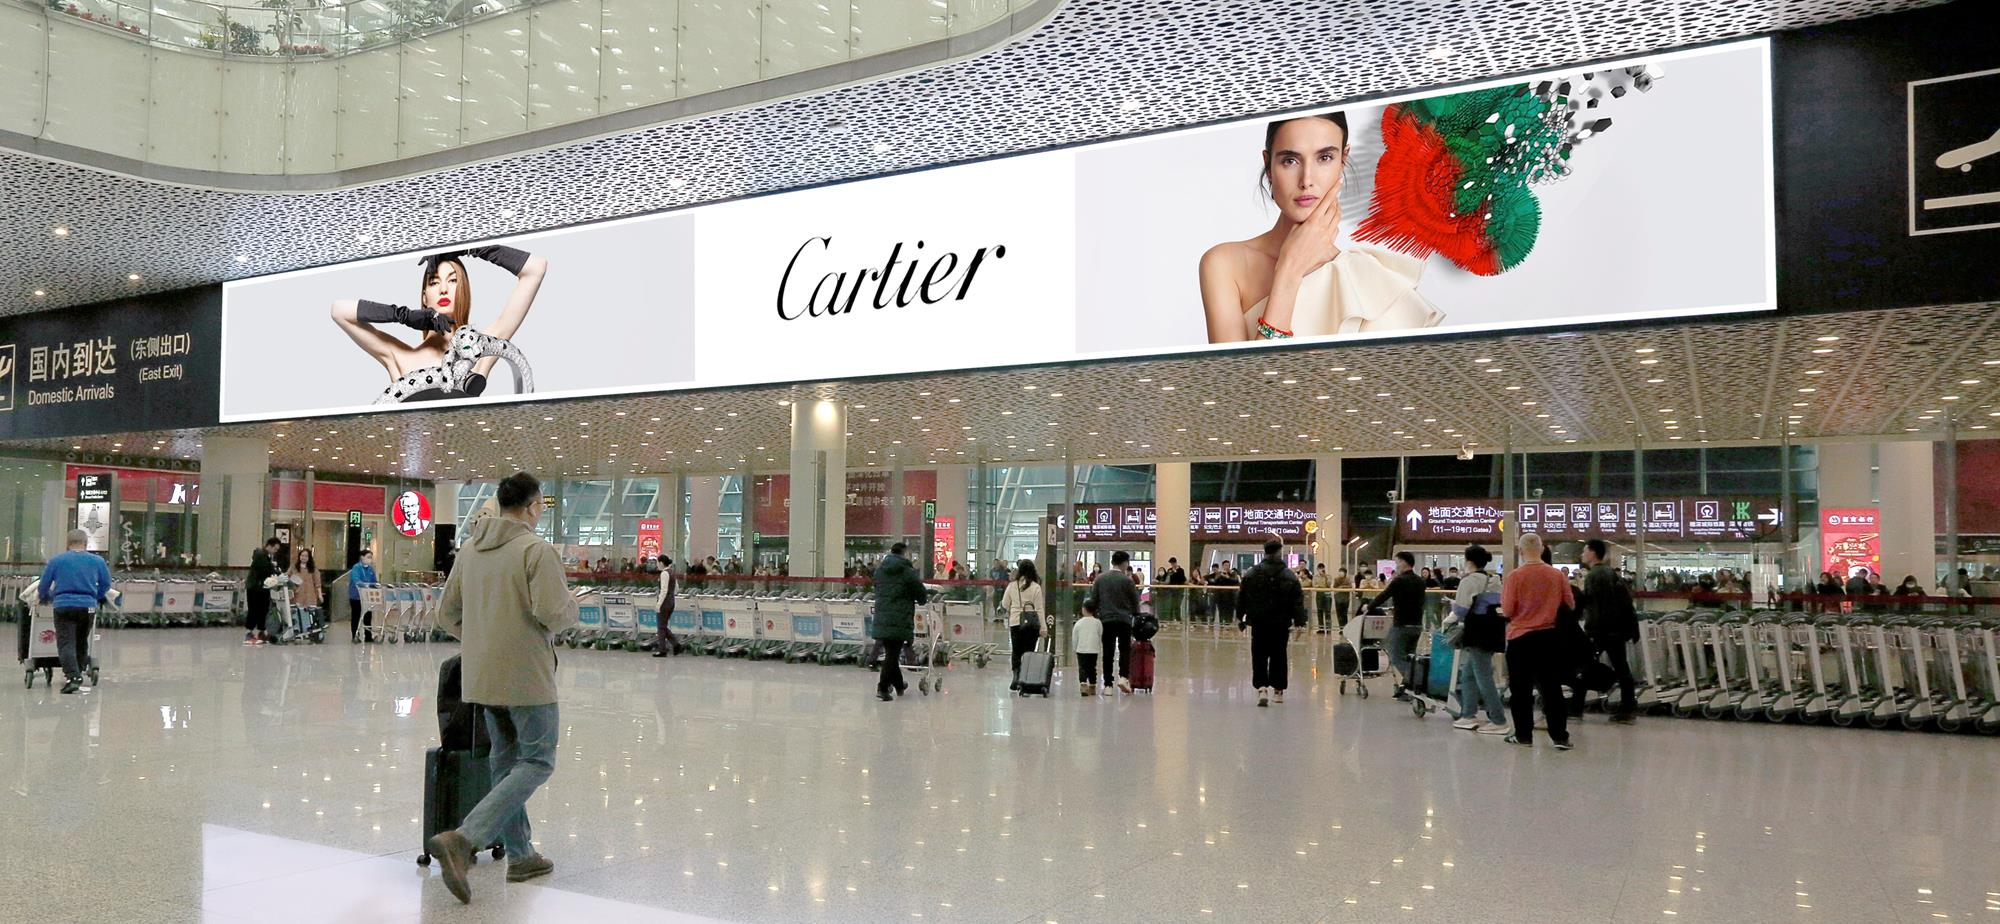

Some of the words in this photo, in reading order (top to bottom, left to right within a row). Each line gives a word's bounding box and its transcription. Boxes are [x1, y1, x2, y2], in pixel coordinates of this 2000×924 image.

[777, 236, 1006, 321] Cartier
[29, 336, 118, 383] 国内到达
[130, 332, 191, 361] (东侧出口)
[139, 366, 162, 384] (East
[163, 363, 183, 381] Exit)
[28, 386, 74, 406] Domestic
[76, 382, 115, 402] Arrivals
